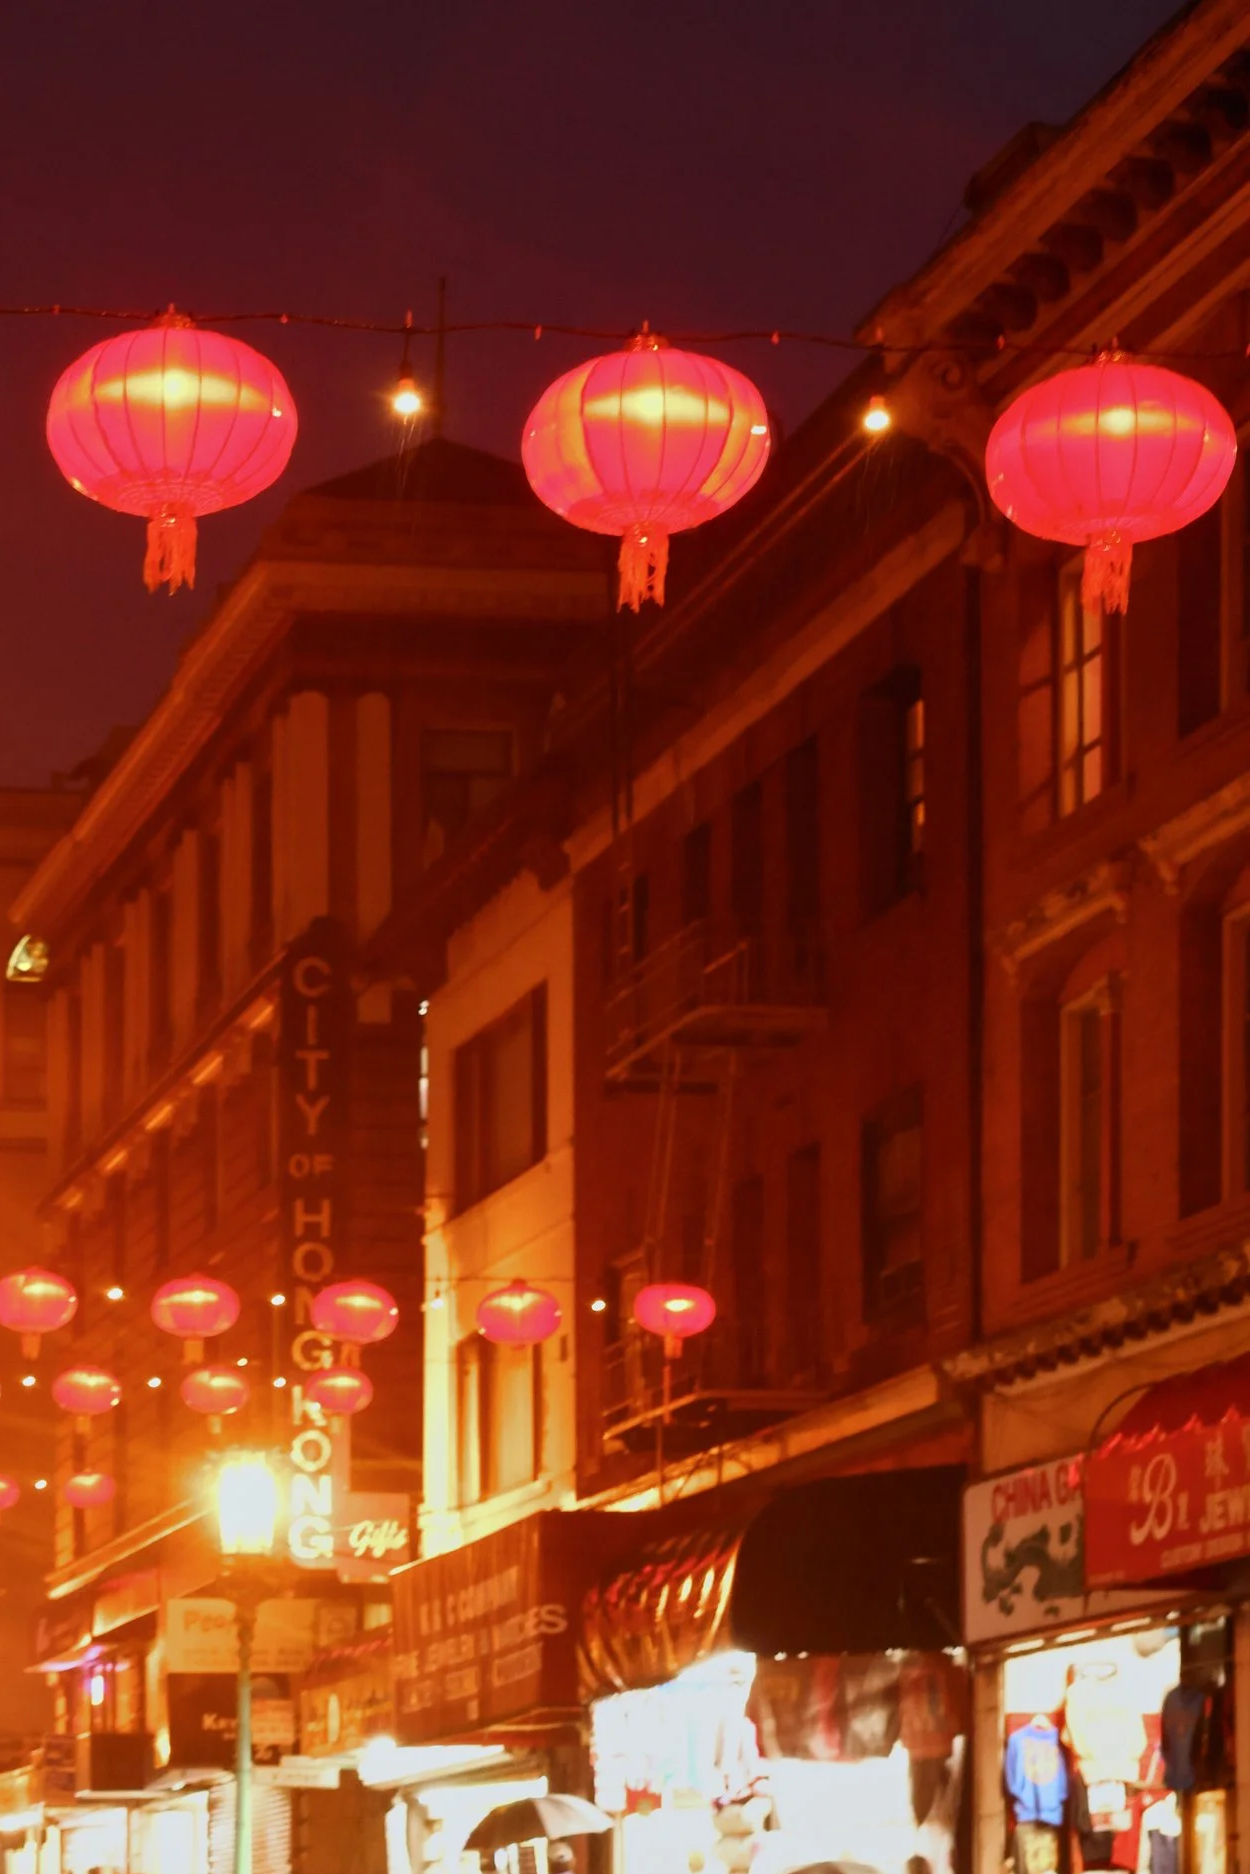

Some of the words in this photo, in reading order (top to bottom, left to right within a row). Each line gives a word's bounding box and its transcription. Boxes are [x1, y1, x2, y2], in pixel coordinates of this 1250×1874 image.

[292, 956, 331, 1136] CITY
[288, 1153, 334, 1179] OF
[991, 1469, 1053, 1525] CHINA
[348, 1519, 408, 1559] Gifts
